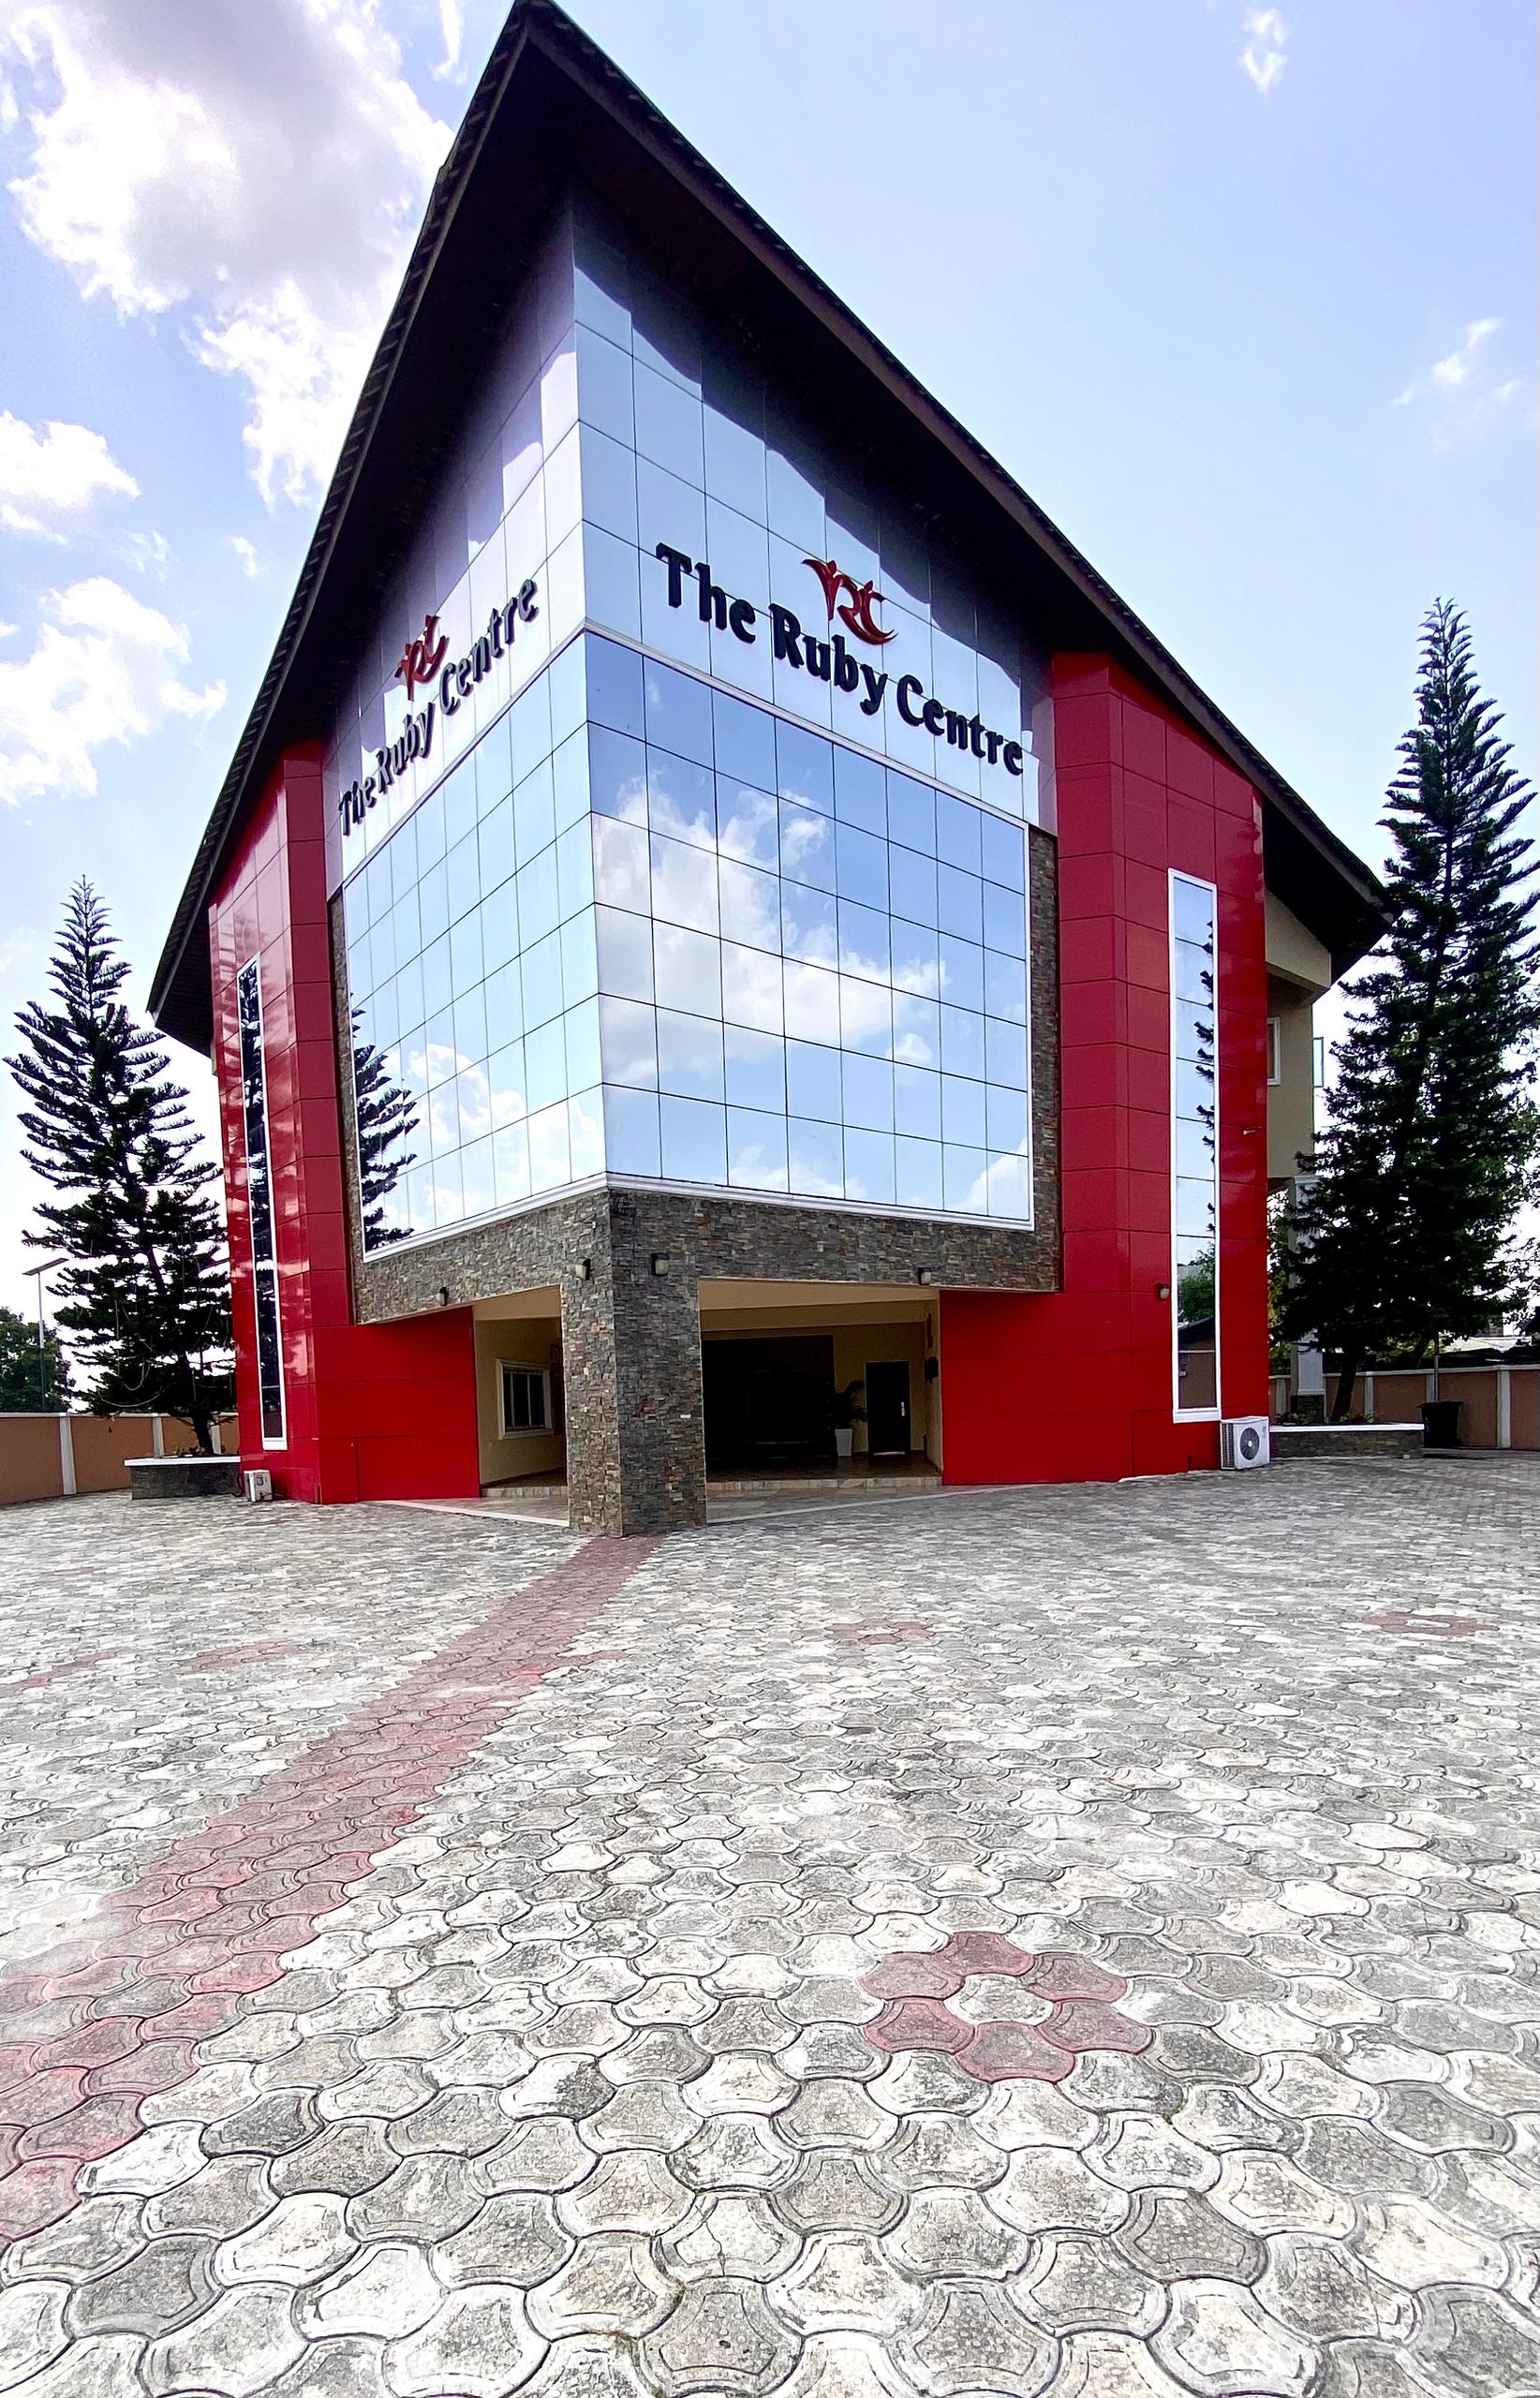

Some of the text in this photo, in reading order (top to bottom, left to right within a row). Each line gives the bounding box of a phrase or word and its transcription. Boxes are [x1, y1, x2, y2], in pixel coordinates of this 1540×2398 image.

[339, 579, 540, 836] The Ruby Centre
[656, 541, 1023, 776] The Ruby Centre
